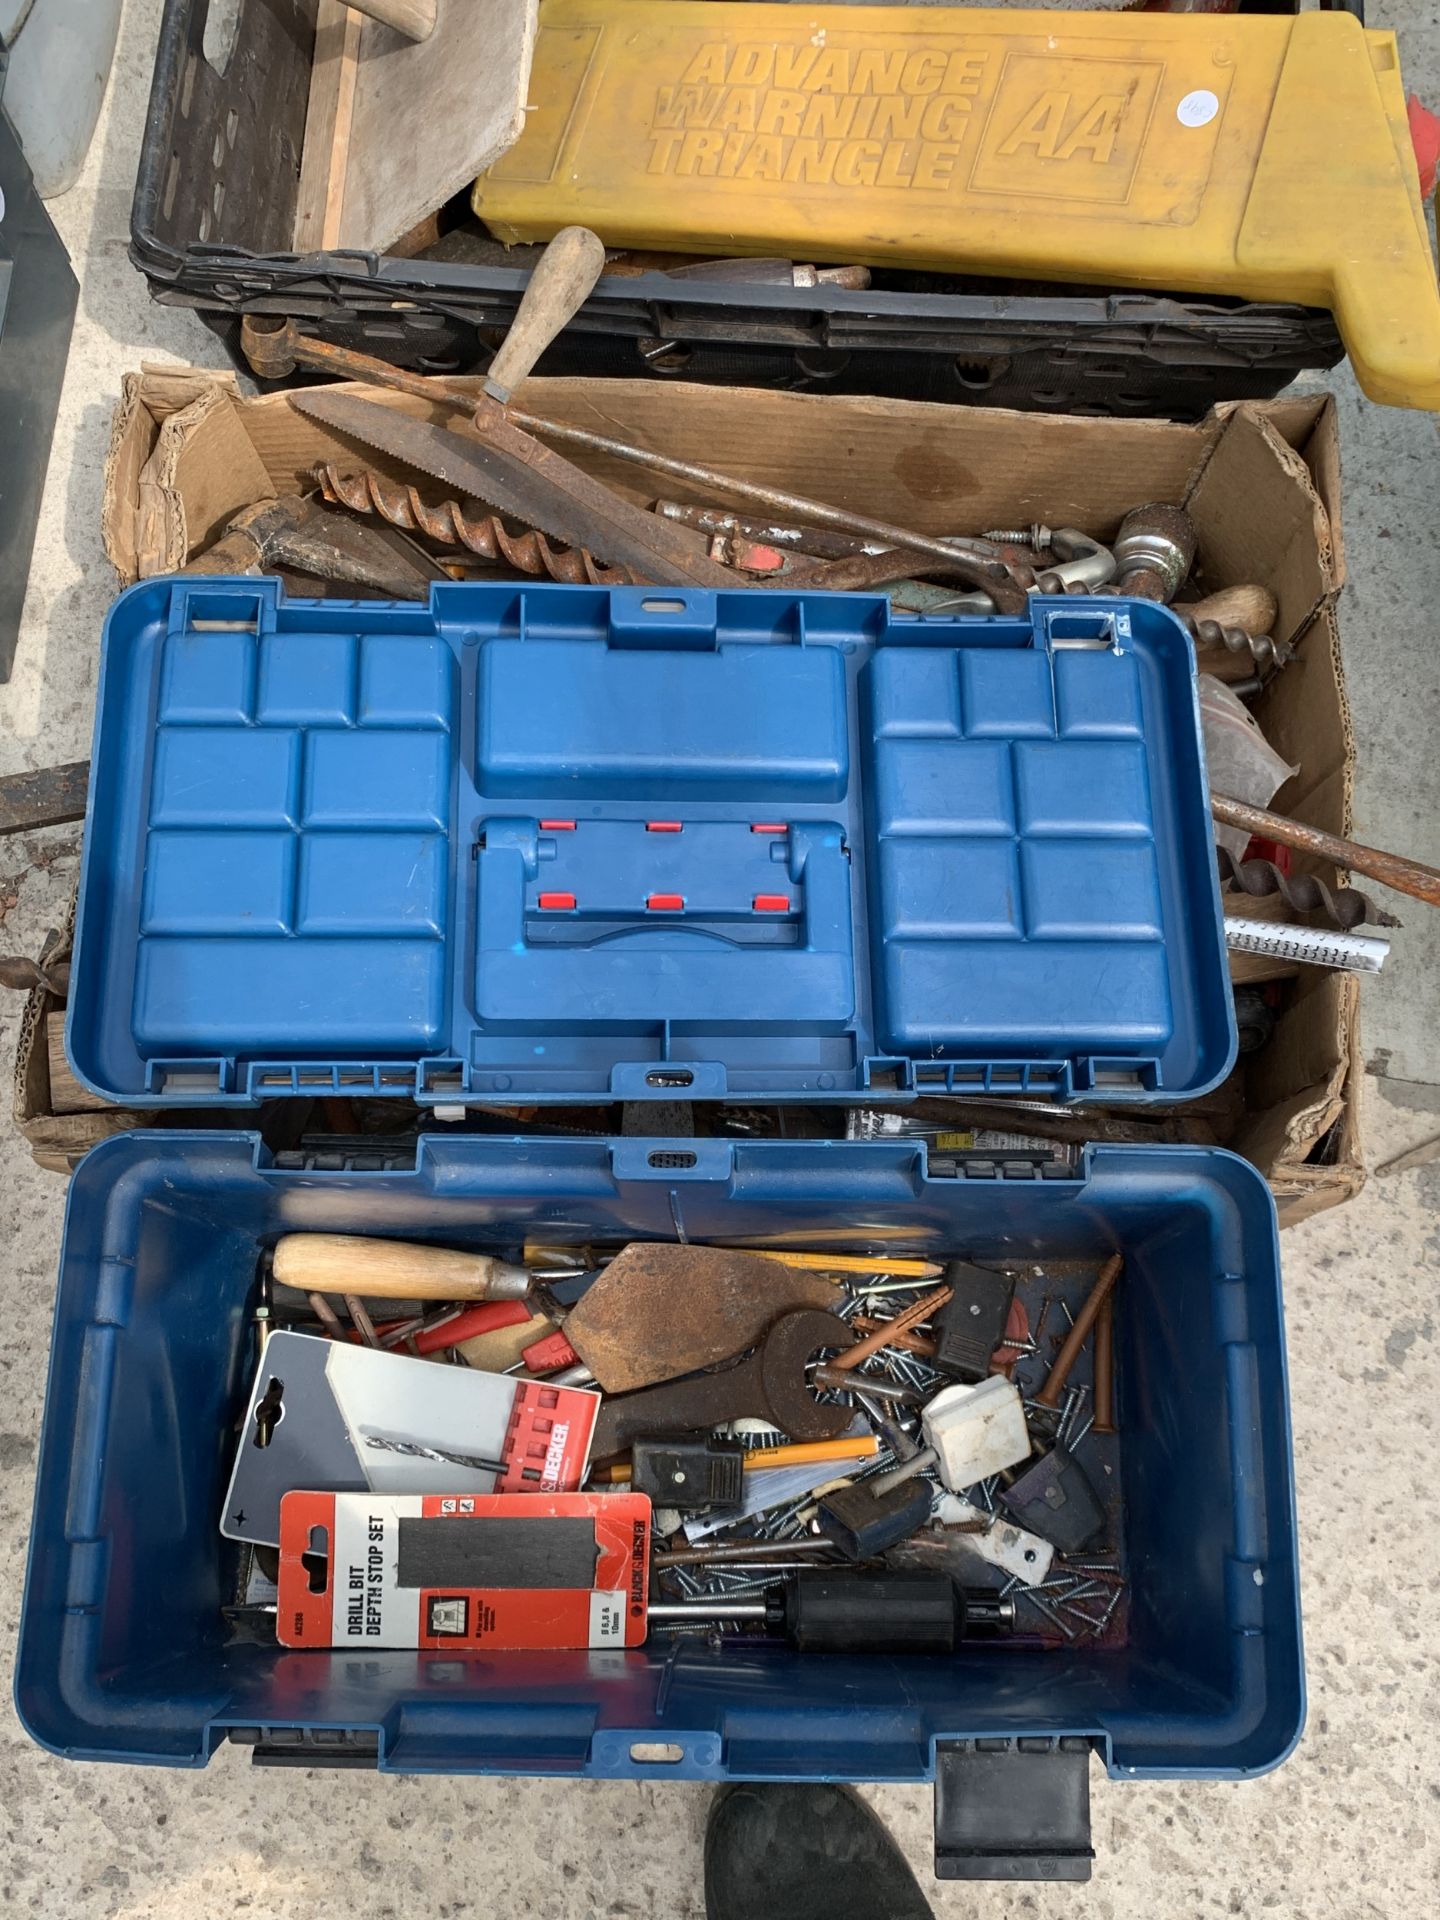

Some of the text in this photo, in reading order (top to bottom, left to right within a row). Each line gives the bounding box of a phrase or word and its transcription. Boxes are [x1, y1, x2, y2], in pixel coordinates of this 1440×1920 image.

[680, 43, 989, 95] ADVANCE
[652, 85, 972, 141] WARNING
[998, 91, 1127, 163] AA
[647, 130, 960, 190] TRIANGLE
[347, 1565, 364, 1636] DRILL BIT
[366, 1515, 384, 1636] DEPTH STOP SET
[611, 1612, 620, 1635] 10mm
